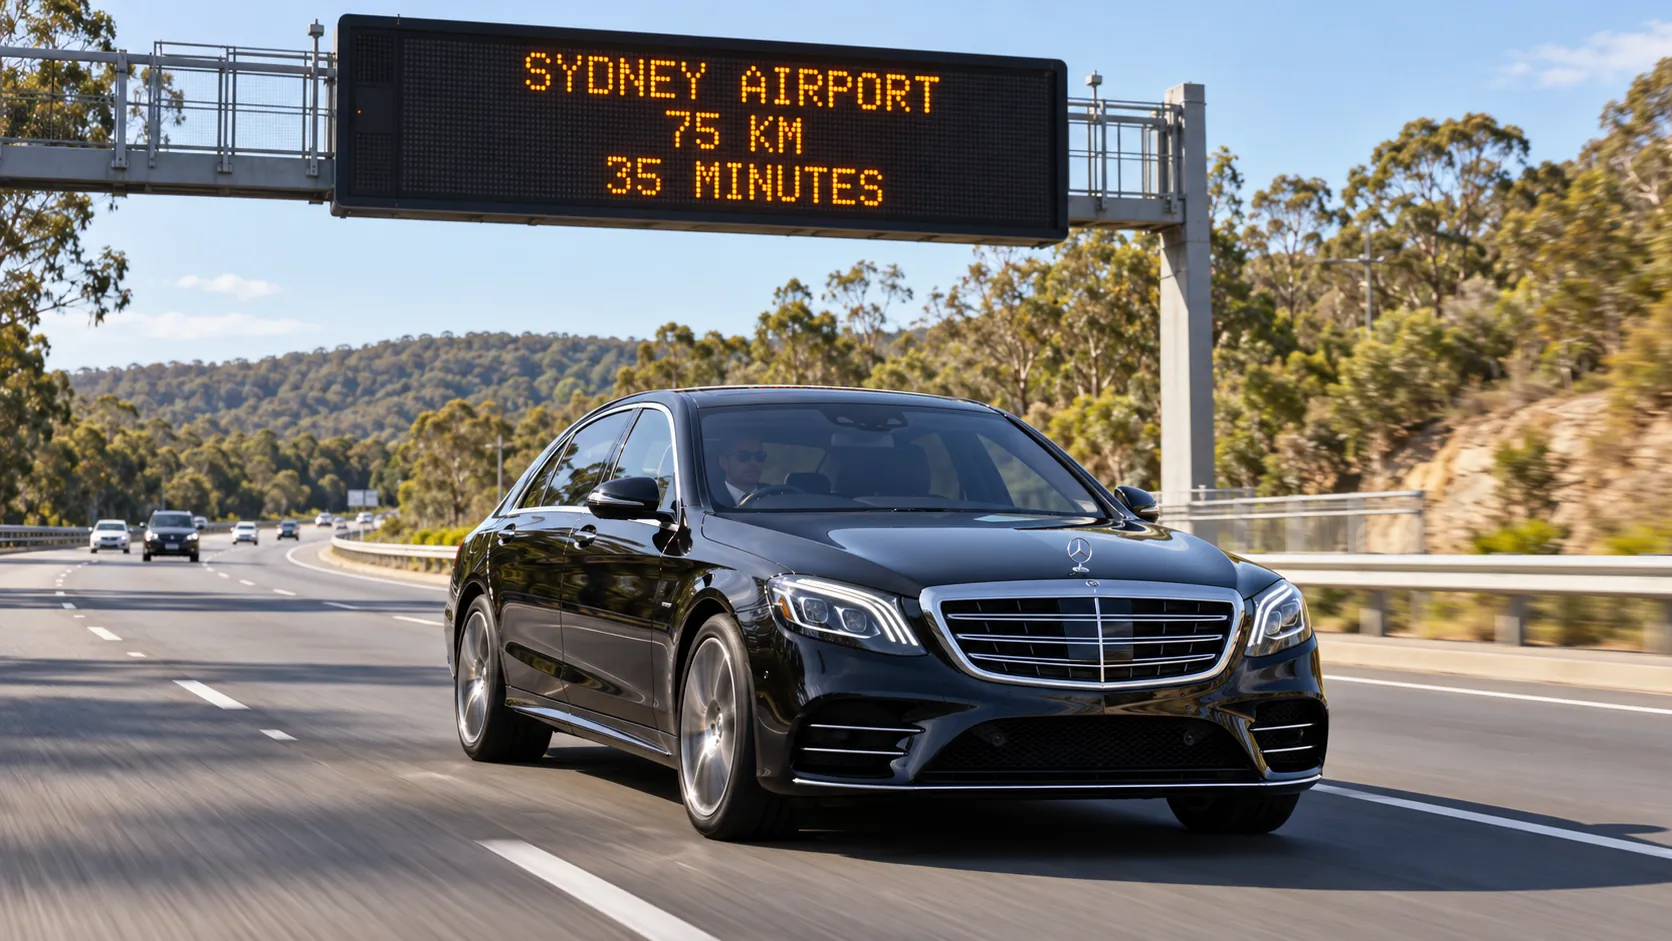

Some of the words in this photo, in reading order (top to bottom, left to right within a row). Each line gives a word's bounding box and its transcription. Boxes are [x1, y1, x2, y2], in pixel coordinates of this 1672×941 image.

[525, 52, 706, 100] SYDNEY
[741, 65, 940, 114] AIRPORT
[665, 109, 720, 150] 75
[750, 114, 802, 155] KM
[606, 155, 661, 196] 35
[695, 160, 884, 207] MINUTES
